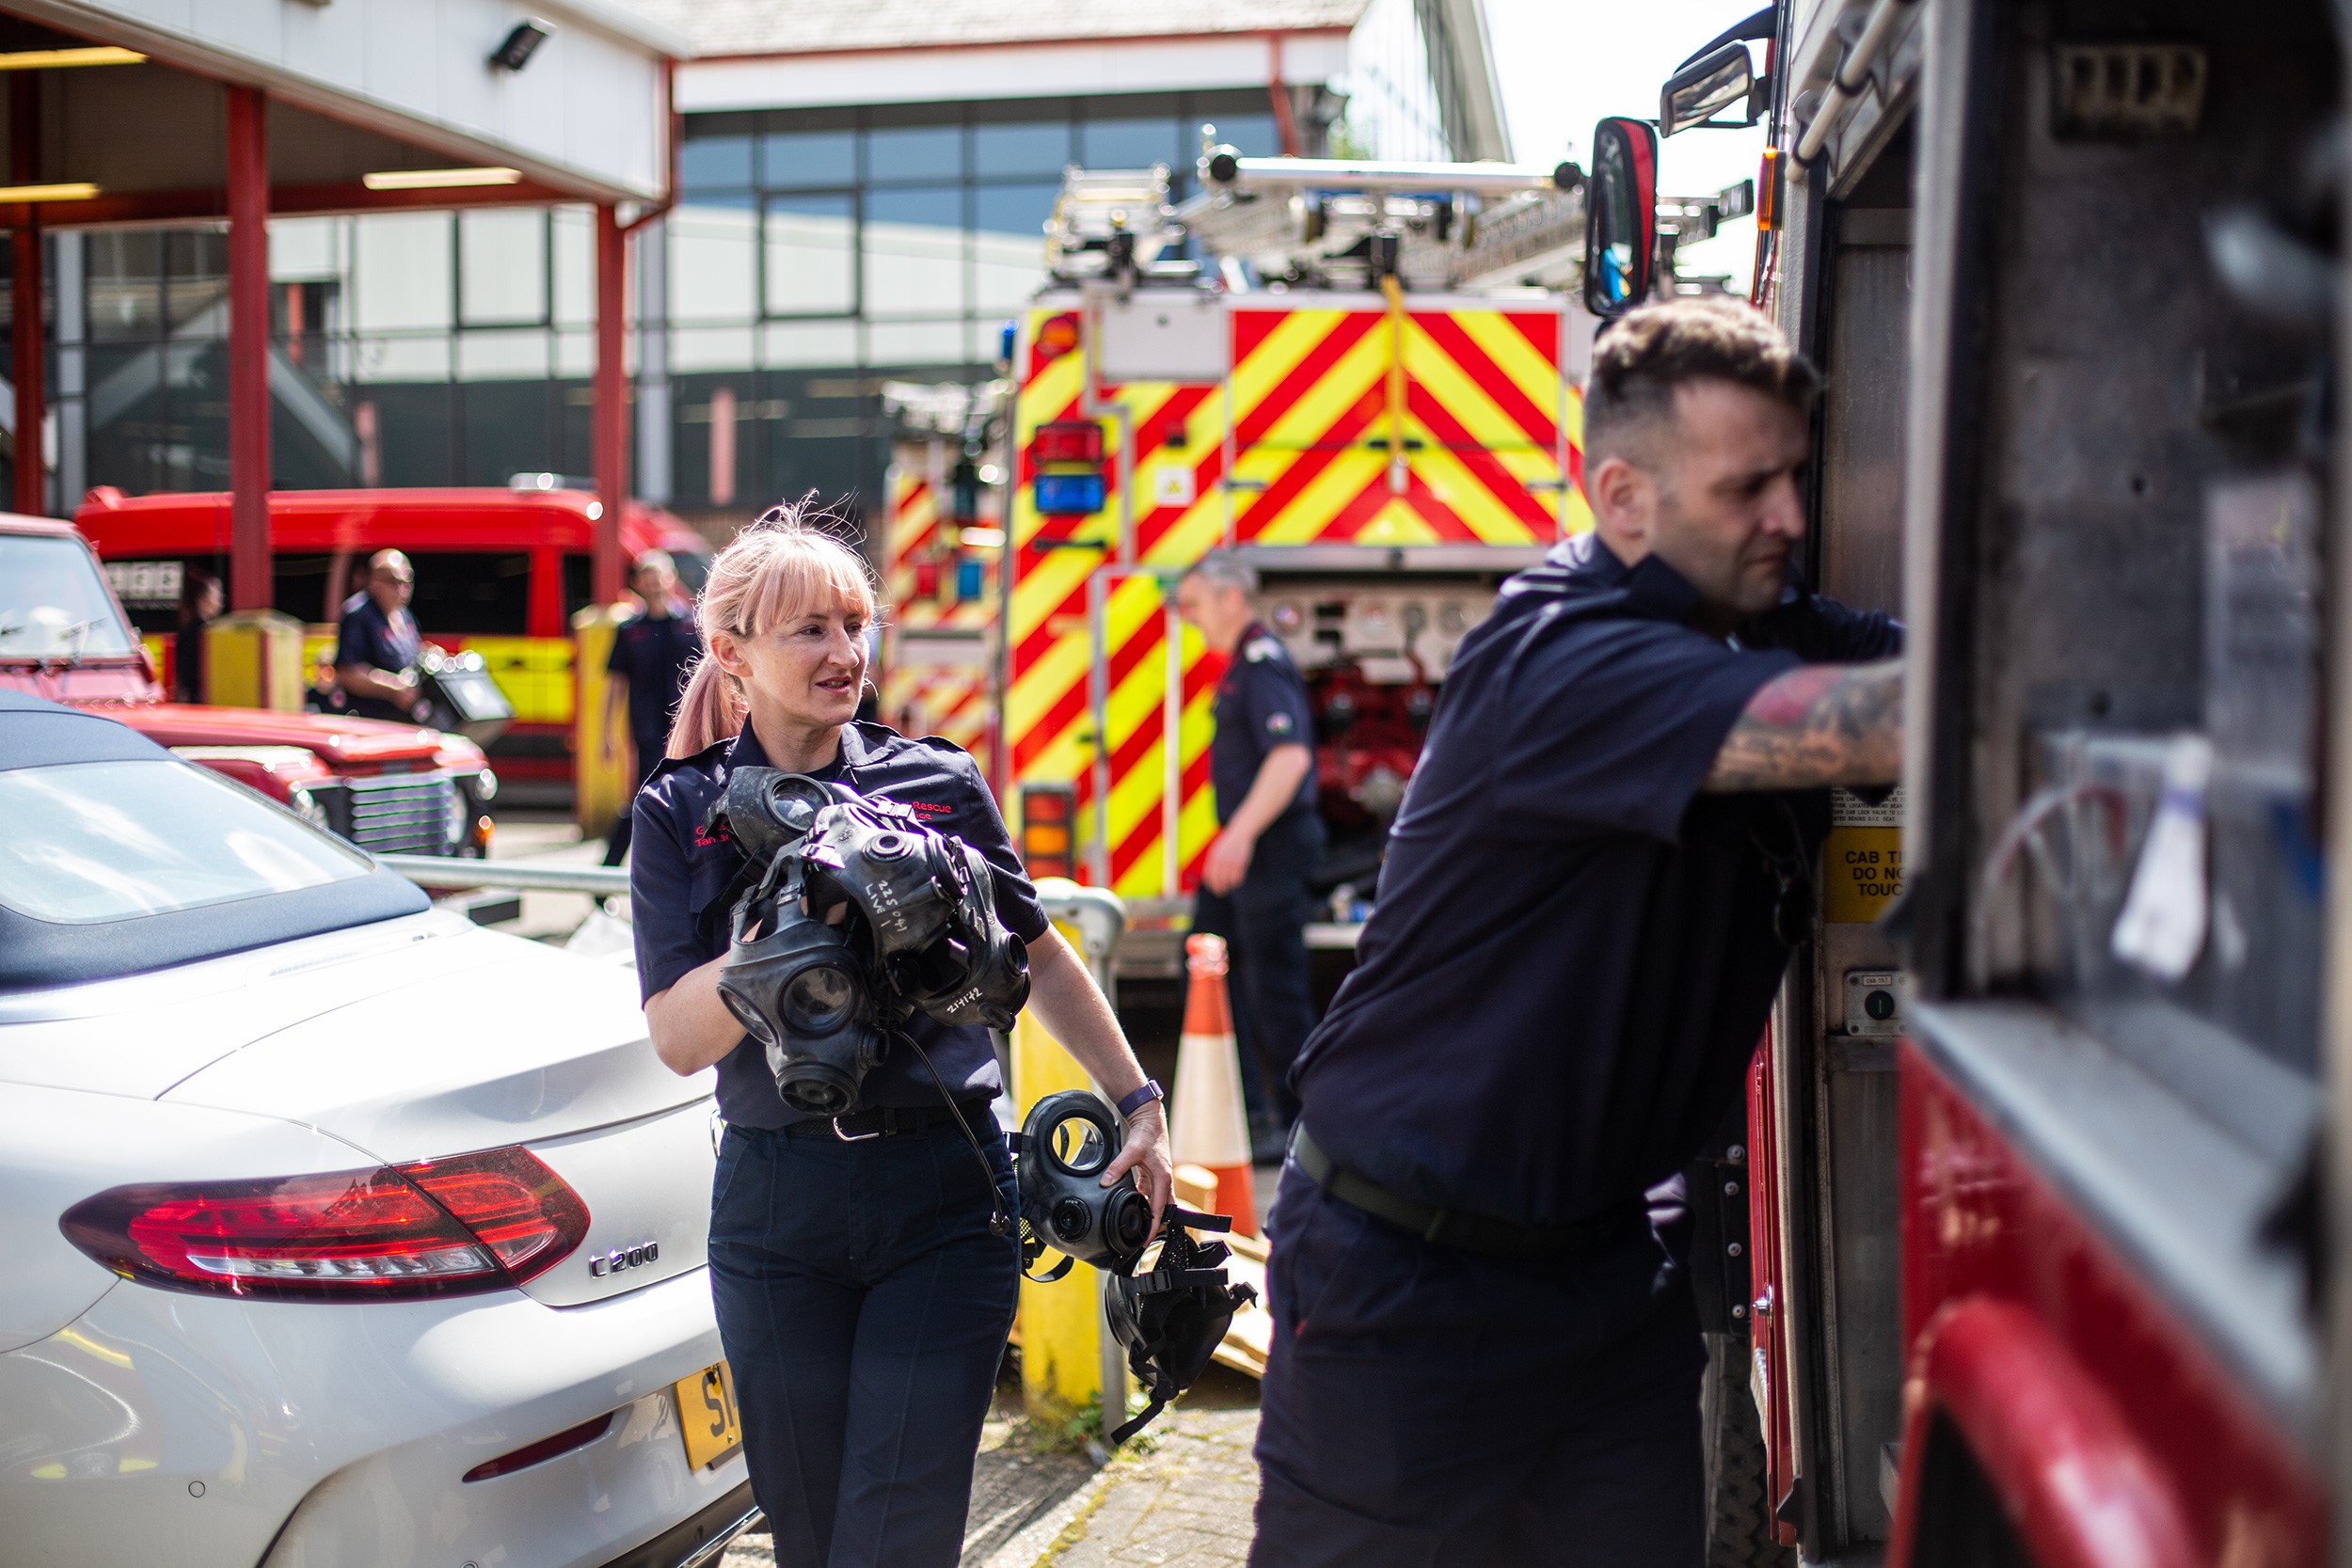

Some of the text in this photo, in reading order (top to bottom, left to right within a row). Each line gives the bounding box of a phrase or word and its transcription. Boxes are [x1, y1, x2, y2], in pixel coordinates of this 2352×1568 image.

[912, 800, 952, 814] Rescue
[1845, 850, 1902, 864] CAB TI
[1852, 866, 1906, 880] DO NO
[1857, 883, 1905, 896] TOUC
